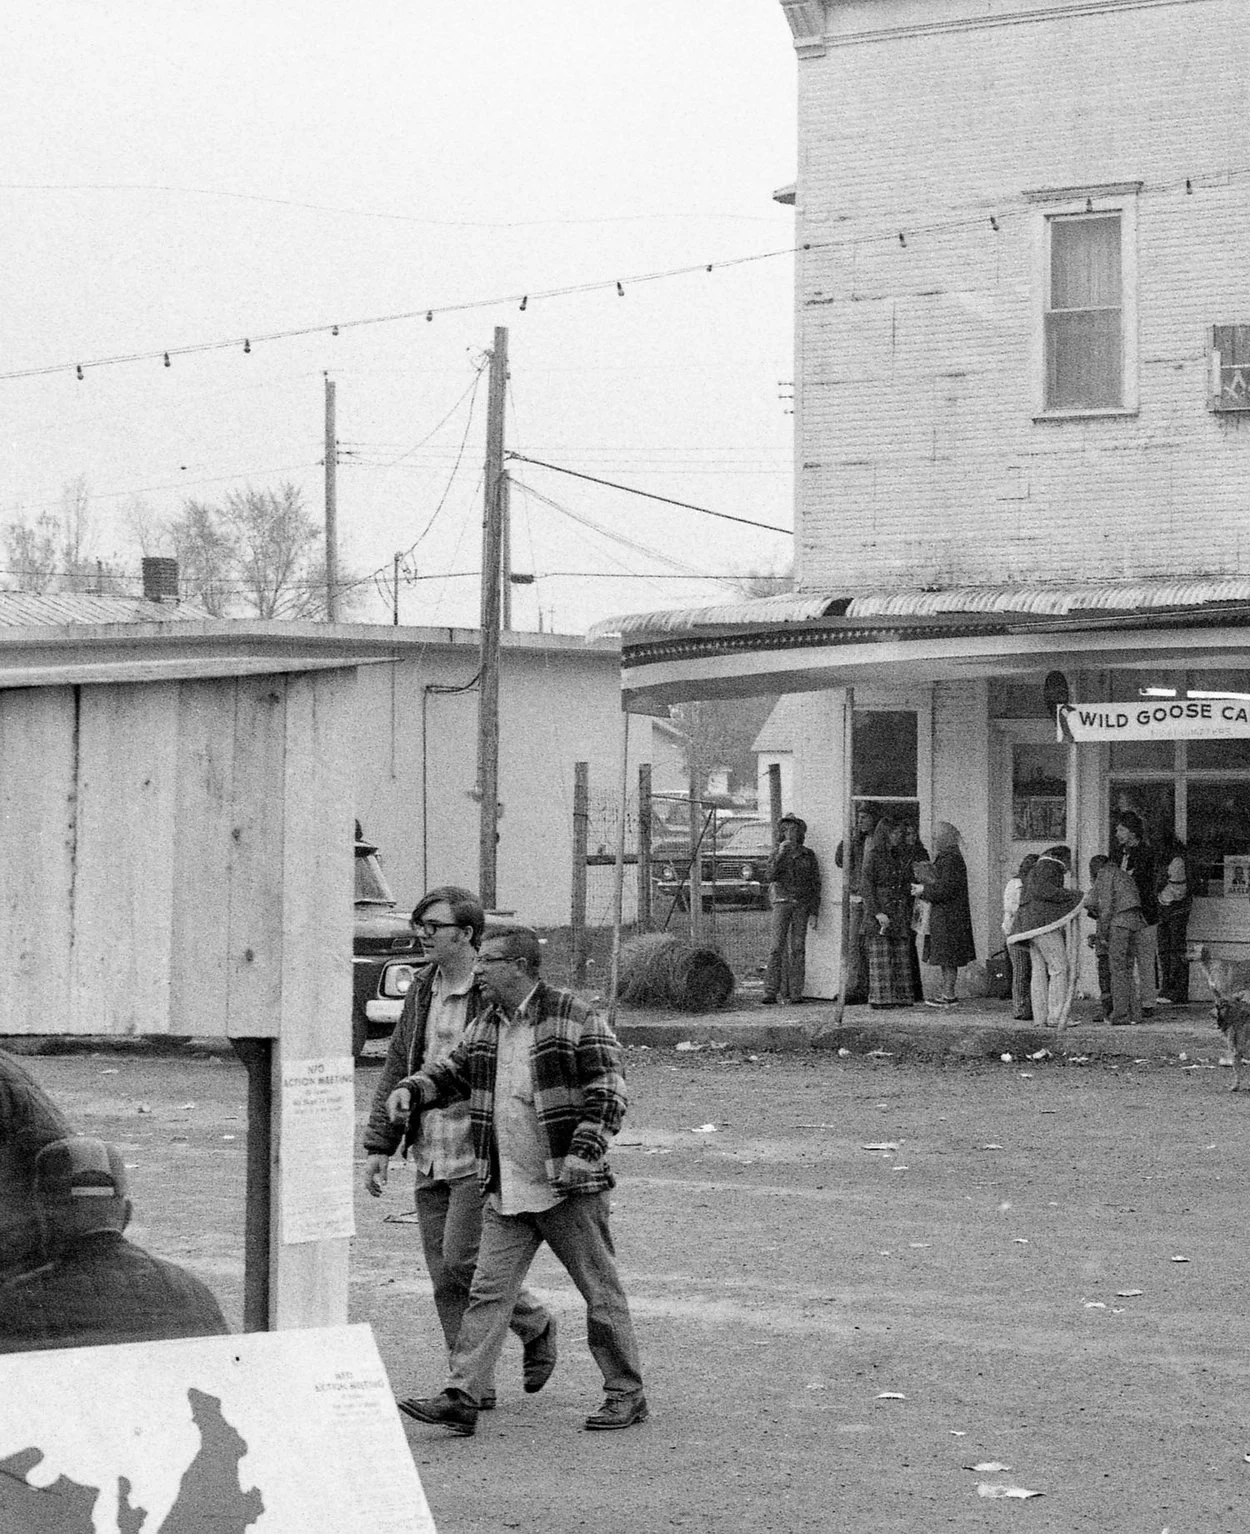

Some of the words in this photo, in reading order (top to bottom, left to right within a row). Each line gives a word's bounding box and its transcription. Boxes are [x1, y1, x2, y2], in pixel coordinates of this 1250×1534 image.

[1079, 711, 1128, 728] WILD
[1137, 703, 1212, 724] GOOSE
[284, 1077, 316, 1088] ACTION
